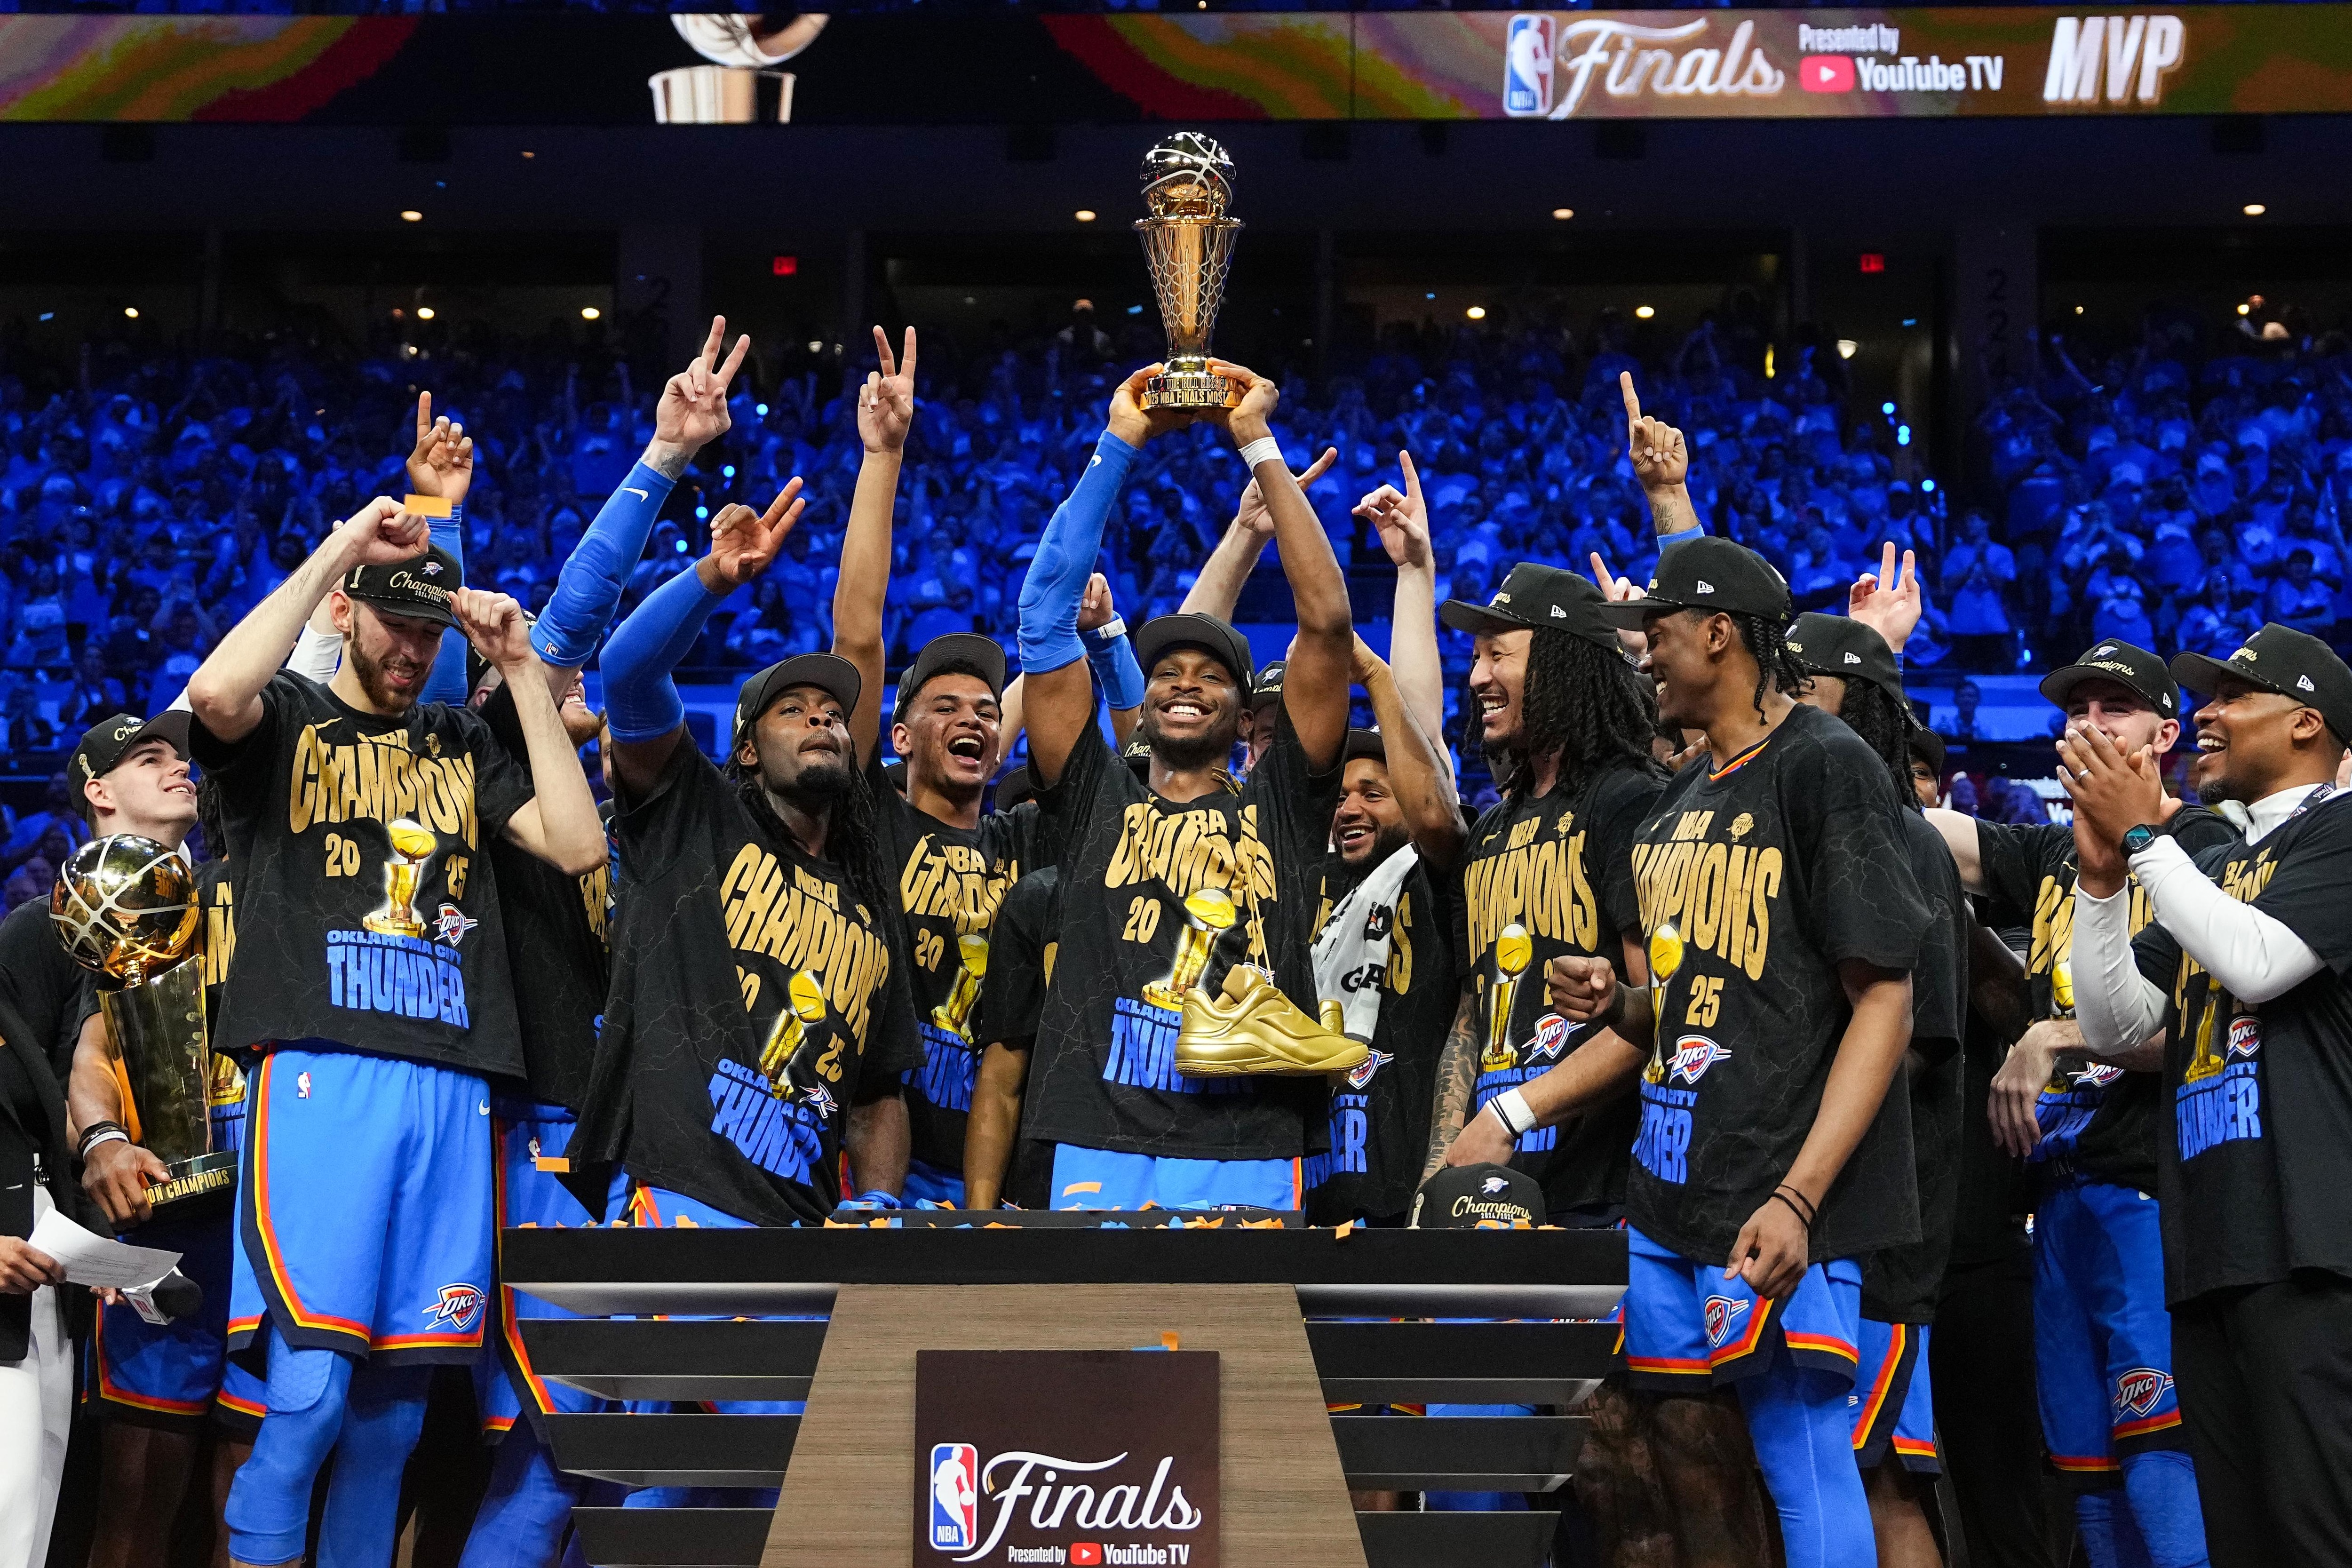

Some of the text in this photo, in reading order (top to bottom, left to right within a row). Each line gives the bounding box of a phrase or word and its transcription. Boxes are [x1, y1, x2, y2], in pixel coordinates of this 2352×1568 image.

[1798, 24, 1900, 55] Presented by
[1548, 18, 1785, 120] Finals
[1856, 56, 2003, 91] YouTube TV
[2043, 15, 2184, 102] MVP
[1160, 391, 1175, 404] NBA
[1177, 390, 1205, 404] FINALS
[1207, 391, 1226, 404] MOST
[1166, 378, 1227, 390] THE BILL RUSSEL
[389, 571, 452, 603] Champion
[289, 724, 478, 852] CHAMPION
[1505, 816, 1541, 851] NBA
[1671, 810, 1715, 841] NBA
[326, 833, 361, 877] 20
[445, 854, 469, 900] 25
[794, 864, 840, 912] NBA
[441, 914, 460, 931] OKC
[1121, 896, 1161, 944] 20
[326, 929, 462, 965] OKLAHOMA CITY
[915, 928, 944, 972] 20
[326, 944, 469, 1029] THUNDER
[1685, 974, 1725, 1028] 25
[1534, 1020, 1563, 1051] OKC
[2230, 1024, 2257, 1047] OKC
[1673, 1045, 1708, 1071] OKC
[2224, 1061, 2258, 1077] CITY
[166, 1169, 230, 1199] CHAMPIONS
[1452, 1195, 1532, 1220] Champions
[440, 1295, 475, 1318] OKC
[1707, 1305, 1722, 1335] OKC
[2120, 1377, 2153, 1408] OKC
[952, 1451, 1201, 1562] Finals
[937, 1525, 959, 1543] NBA
[1008, 1546, 1066, 1565] Presented by
[1104, 1544, 1190, 1565] YouTube TV
